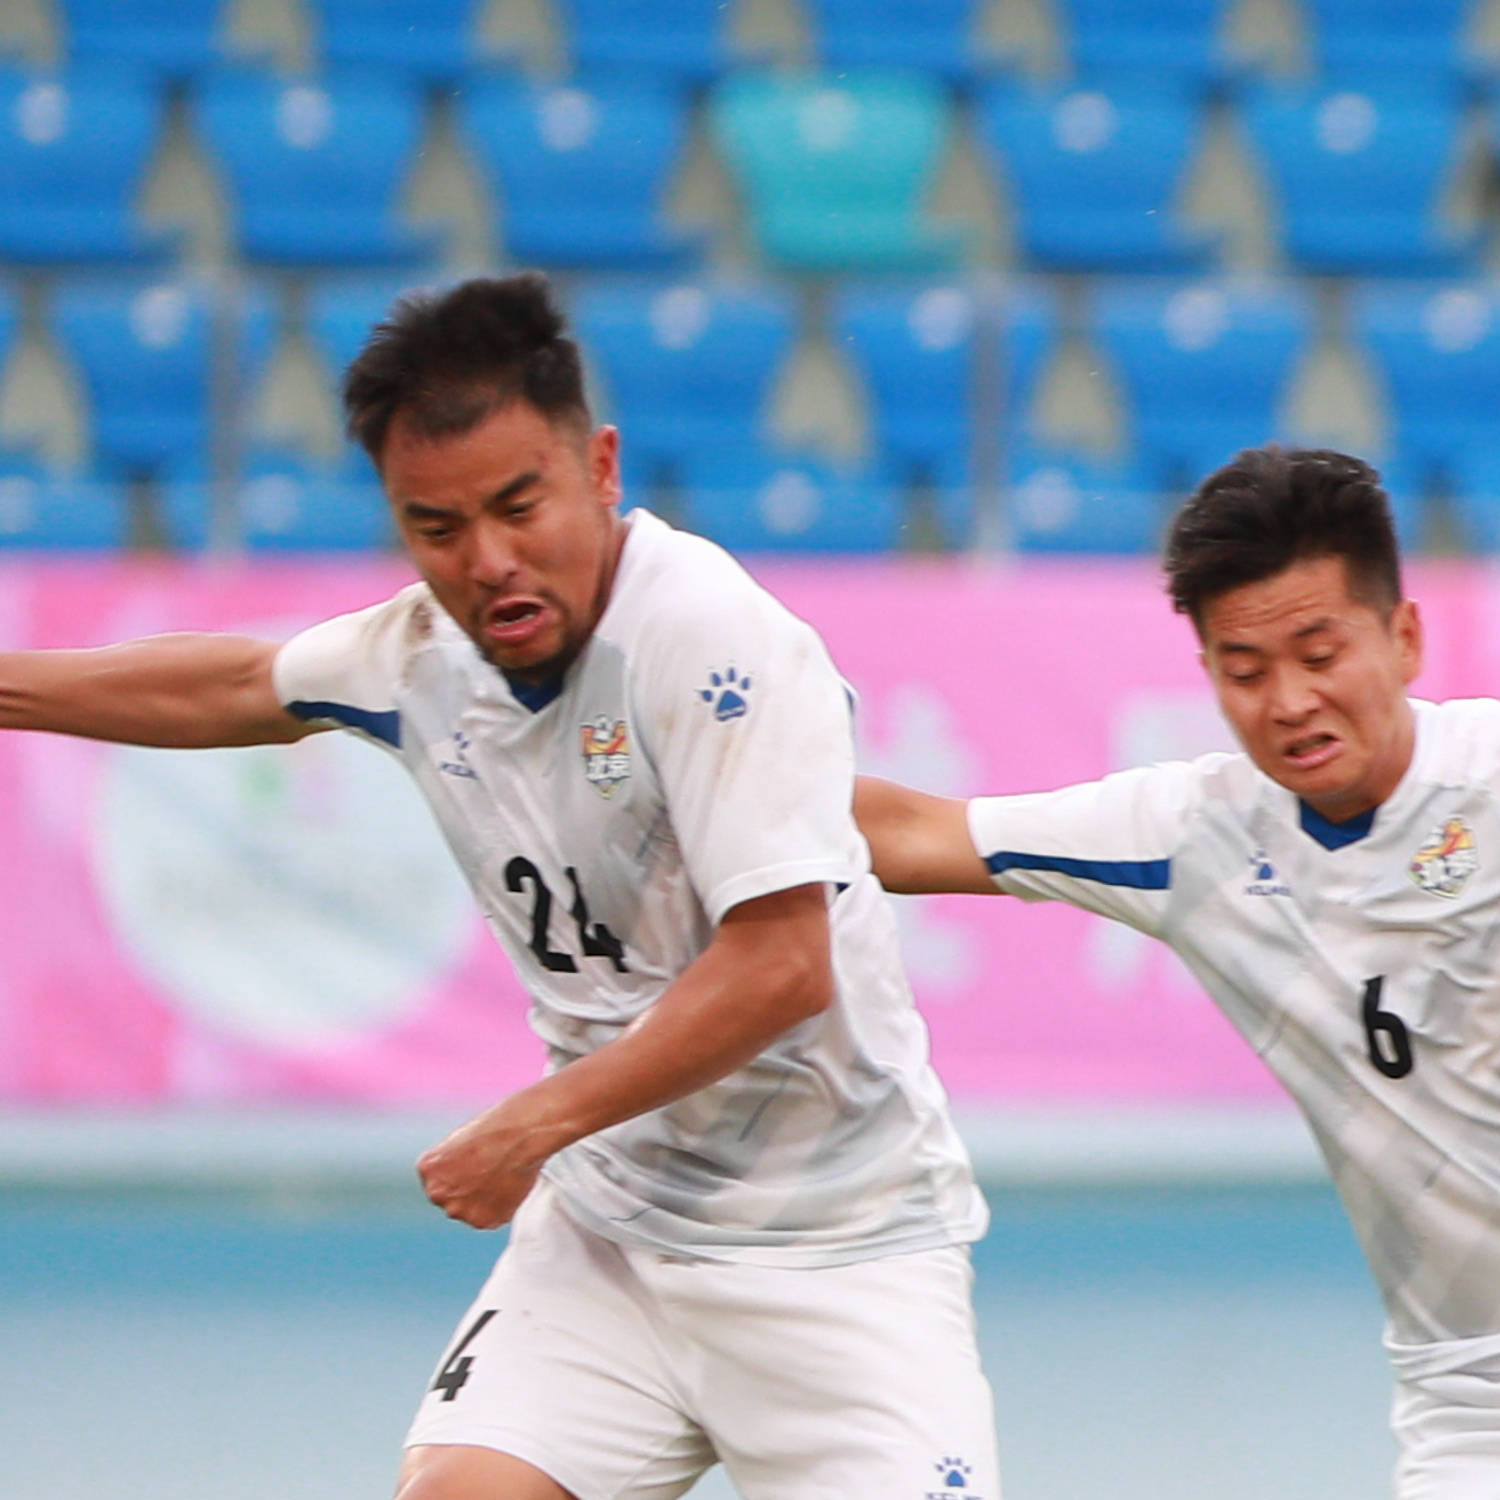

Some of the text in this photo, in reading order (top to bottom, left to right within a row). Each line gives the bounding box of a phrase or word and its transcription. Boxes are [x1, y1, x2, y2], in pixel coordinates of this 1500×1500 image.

[504, 856, 630, 973] 24
[1361, 974, 1414, 1079] 6
[429, 1309, 499, 1402] 4
